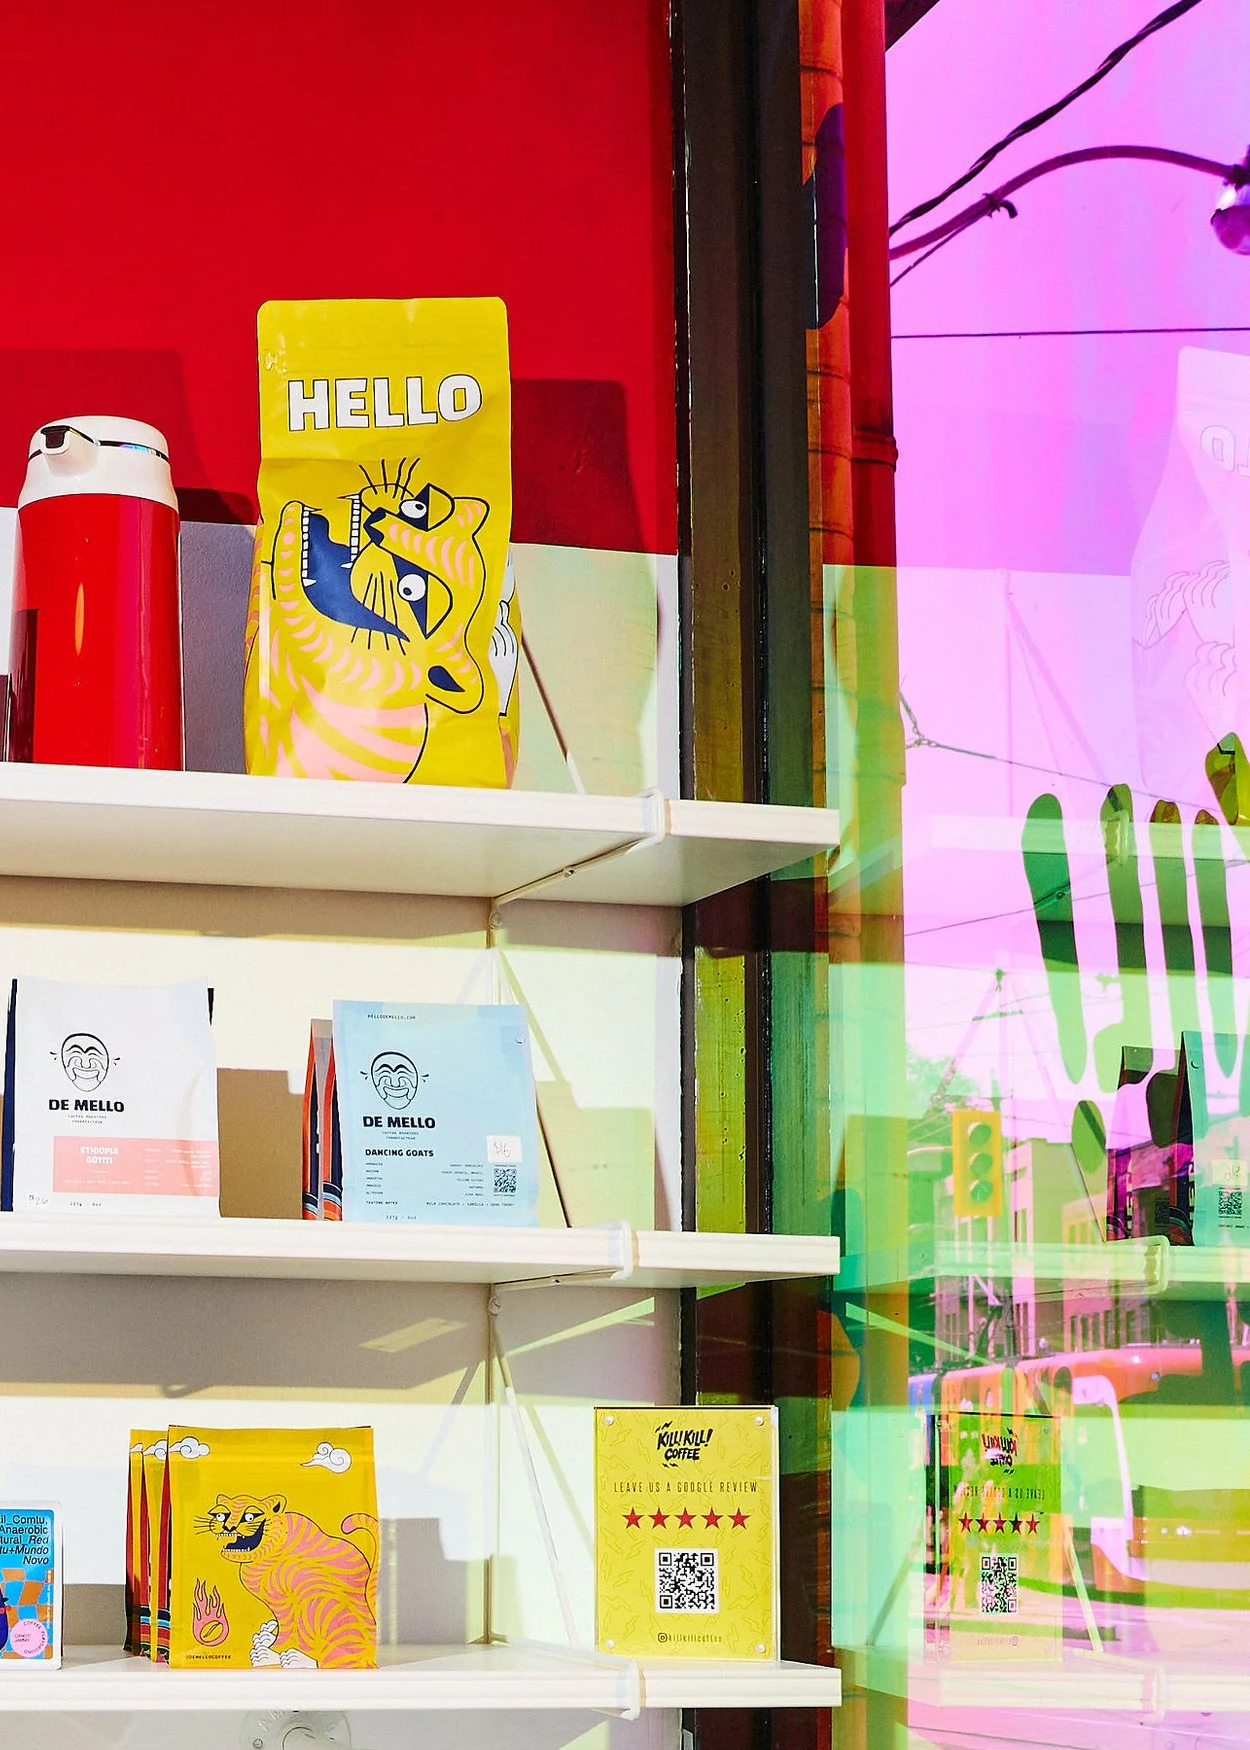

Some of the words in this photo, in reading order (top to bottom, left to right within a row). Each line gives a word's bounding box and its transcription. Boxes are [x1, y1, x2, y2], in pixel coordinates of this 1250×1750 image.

[288, 374, 483, 431] HELLO
[48, 1099, 70, 1111] DE
[74, 1099, 125, 1113] MELLO
[362, 1116, 383, 1128] DE
[387, 1116, 436, 1129] MELLO
[365, 1148, 404, 1157] DANCING
[406, 1149, 434, 1157] GOATS
[683, 1427, 713, 1448] KILL!
[664, 1447, 702, 1462] COFFEE
[613, 1482, 643, 1494] LEAVE
[648, 1482, 662, 1494] US
[666, 1482, 672, 1494] A
[676, 1482, 715, 1494] GOOGLE
[719, 1482, 758, 1494] REVIEW
[22, 1555, 49, 1565] Novo
